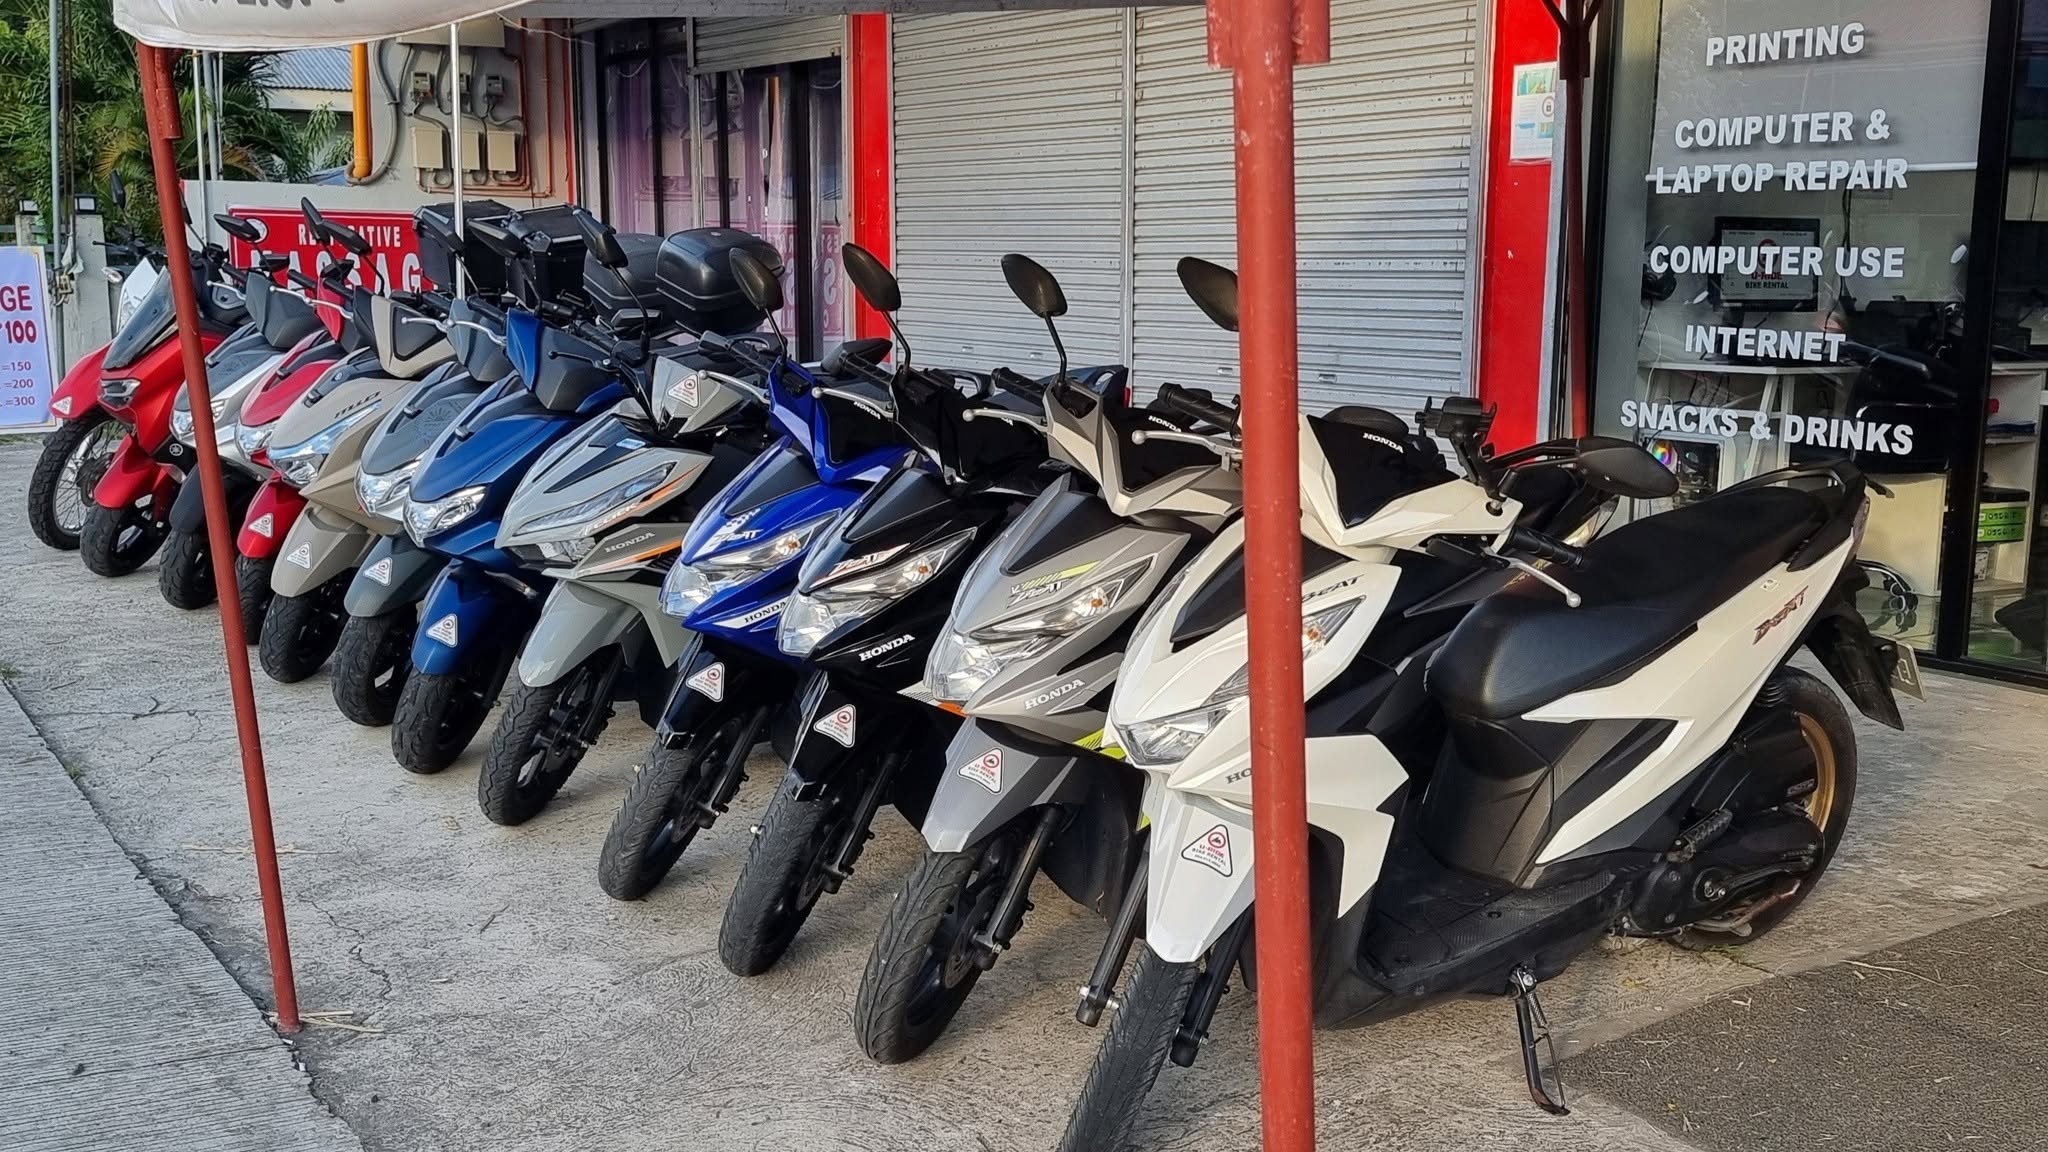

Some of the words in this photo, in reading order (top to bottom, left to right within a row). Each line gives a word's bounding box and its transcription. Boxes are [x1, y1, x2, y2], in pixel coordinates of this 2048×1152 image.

[1706, 22, 1865, 66] PRINTING
[1674, 111, 1853, 149] COMPUTER
[1865, 108, 1891, 140] &
[1655, 162, 1774, 194] LAPTOP
[1784, 158, 1908, 192] REPAIR
[1650, 245, 1823, 277] COMPUTER
[1835, 247, 1905, 278] USE
[1763, 281, 1789, 289] RENTAL
[0, 320, 37, 344] 100
[1685, 324, 1846, 363] INTERNET
[1148, 415, 1182, 433] HONDA
[1620, 400, 1738, 438] SNACKS
[1750, 411, 1772, 440] &
[1783, 414, 1914, 456] DRINKS
[1362, 432, 1404, 454] HONDA
[604, 532, 656, 553] HONDA
[744, 601, 786, 623] HONDA
[858, 634, 916, 662] HONDA
[1024, 679, 1086, 710] HONDA
